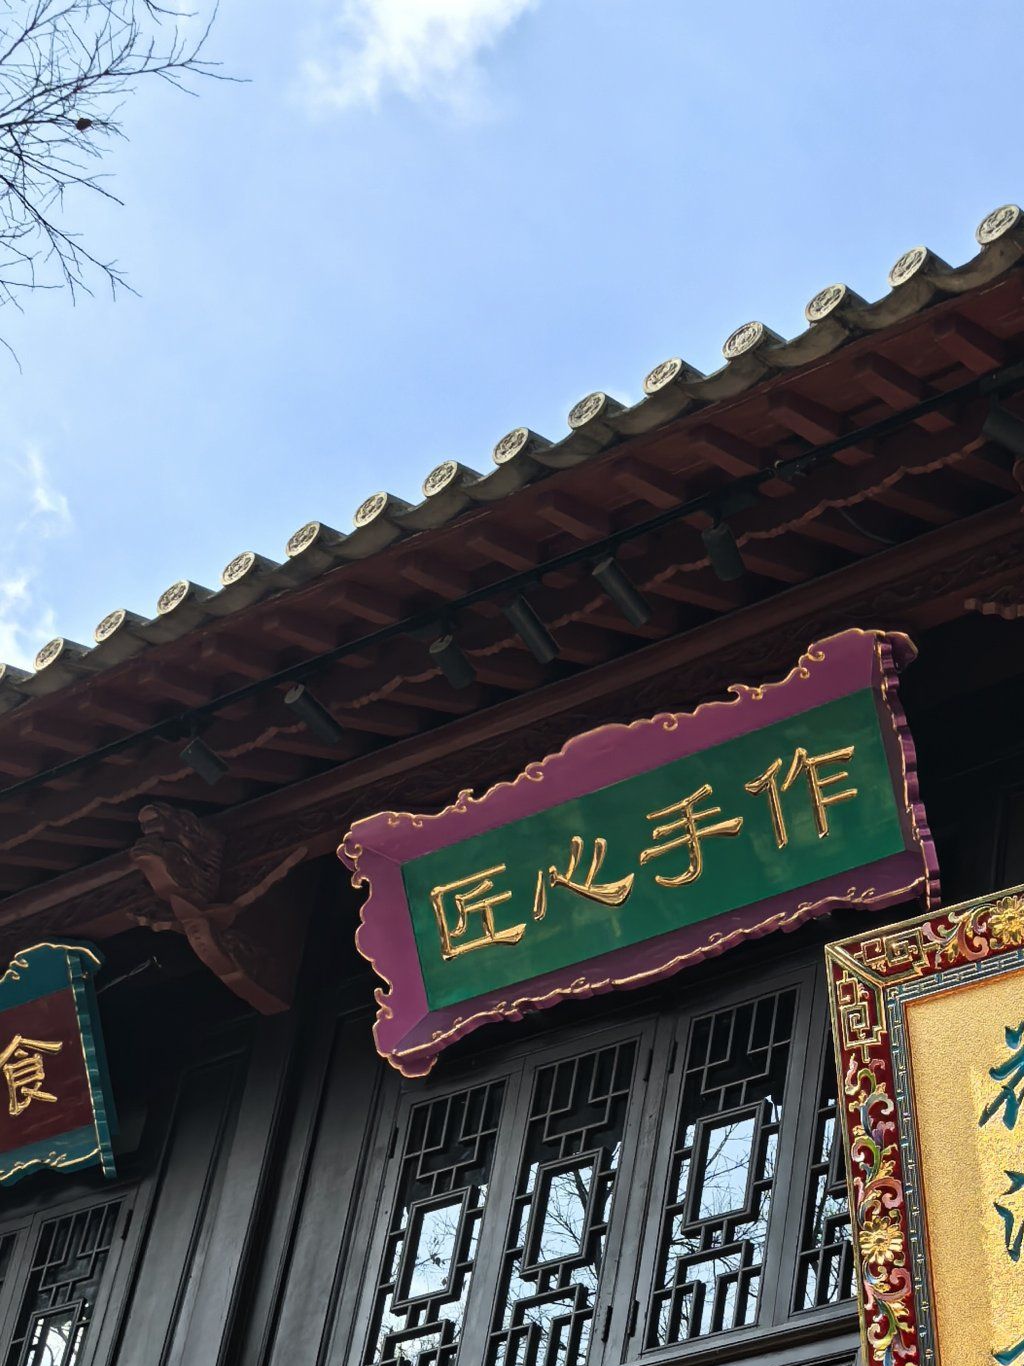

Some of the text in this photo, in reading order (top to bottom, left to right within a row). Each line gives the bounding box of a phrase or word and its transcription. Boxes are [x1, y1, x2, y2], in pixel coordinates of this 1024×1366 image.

[430, 745, 859, 960] 匠心手作
[0, 1033, 63, 1116] 食
